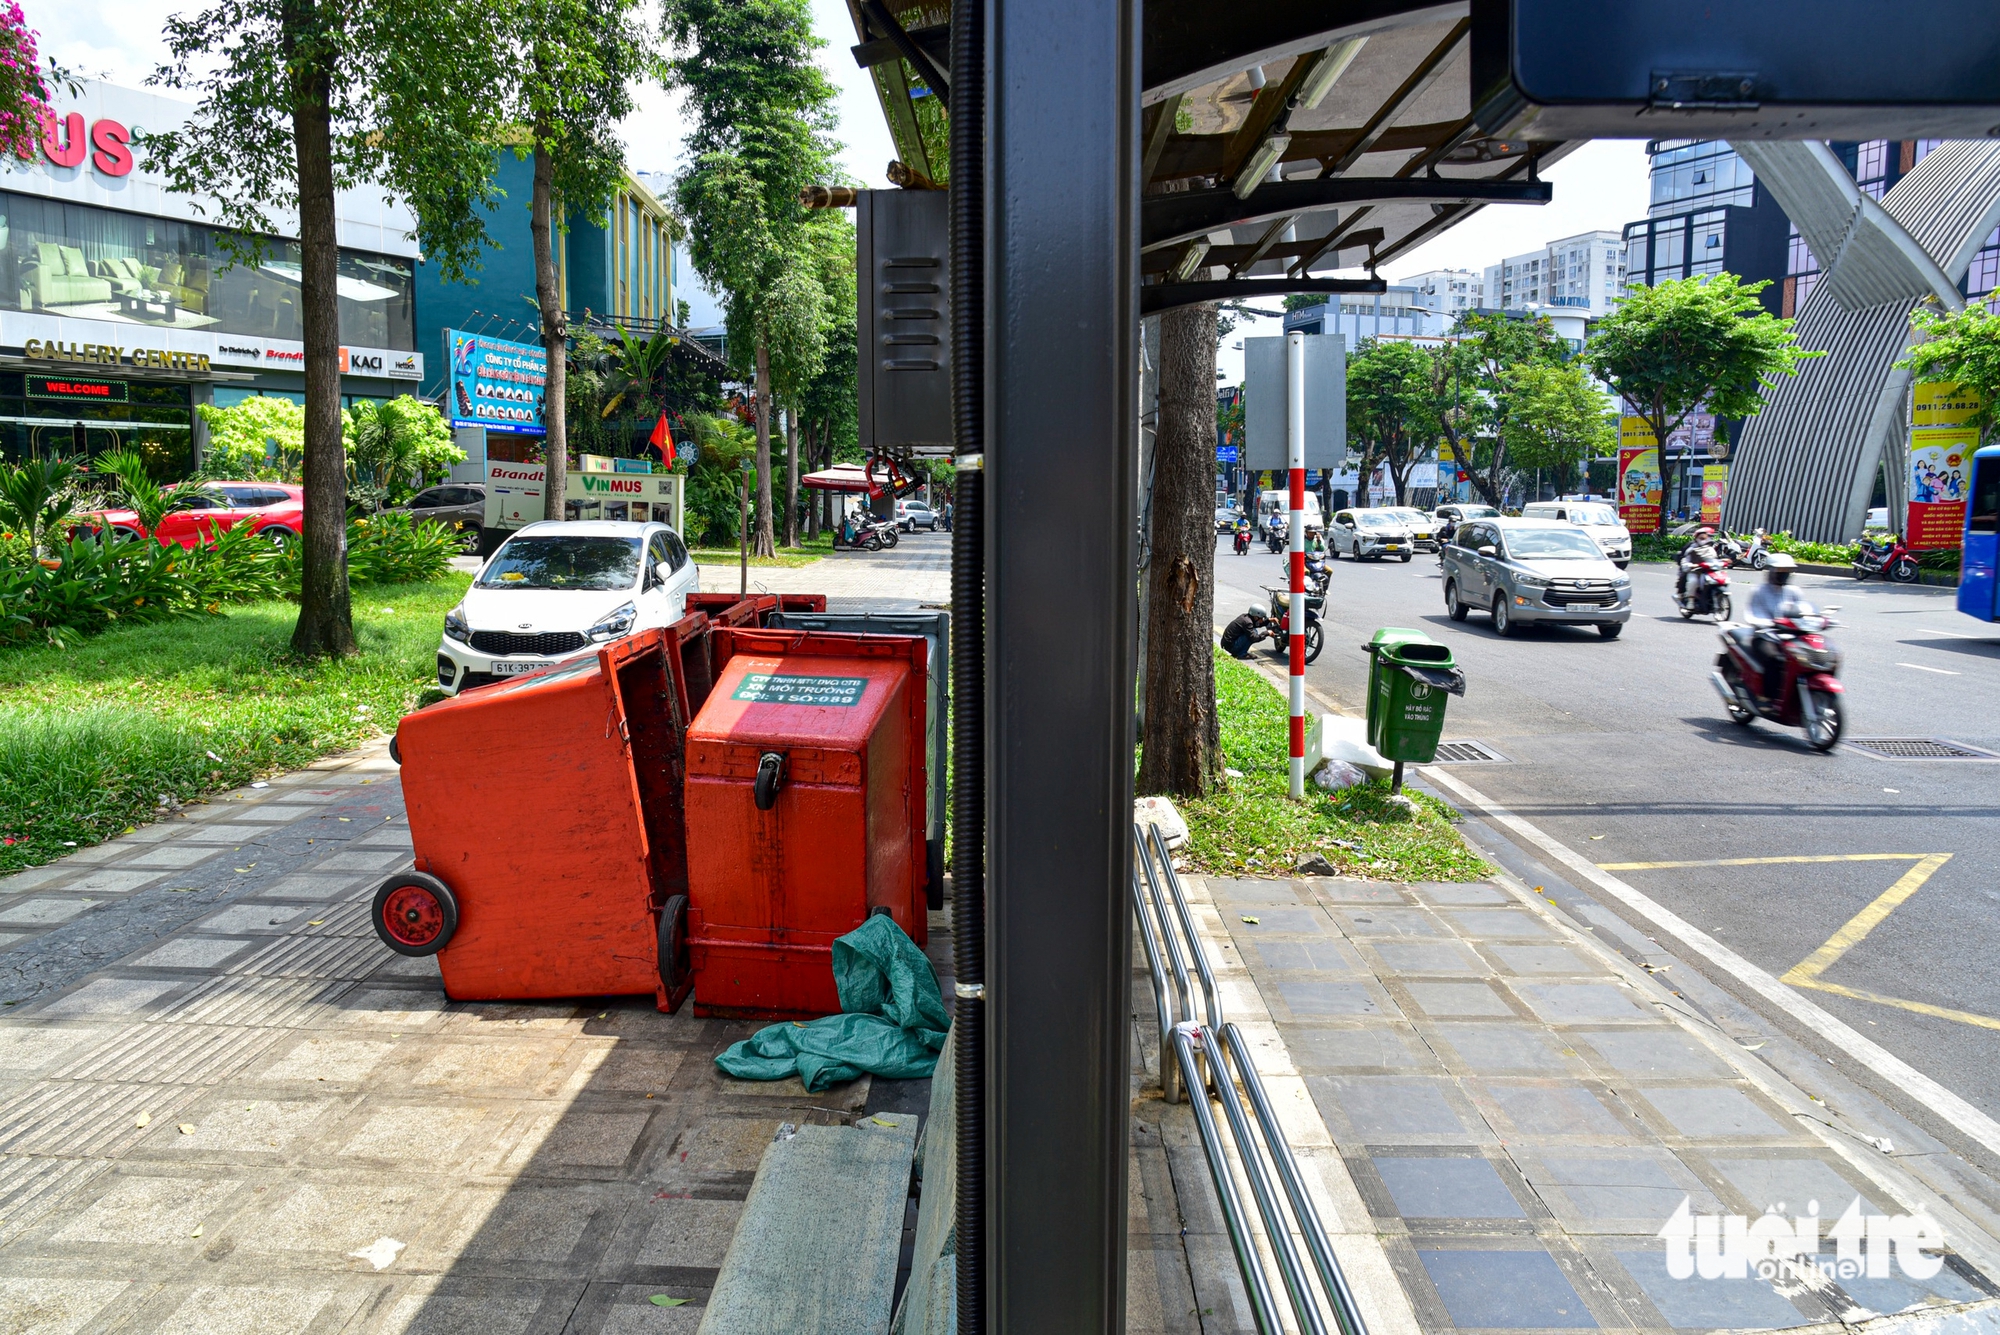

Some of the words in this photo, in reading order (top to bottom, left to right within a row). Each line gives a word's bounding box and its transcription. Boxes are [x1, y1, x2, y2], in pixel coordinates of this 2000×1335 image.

[17, 101, 133, 177] US
[25, 338, 124, 365] GALLERY
[132, 348, 212, 372] CENTER
[266, 350, 304, 360] Brandt
[352, 354, 382, 370] KACI
[485, 352, 502, 366] CÔNG
[504, 357, 512, 366] TY
[513, 356, 521, 368] CỔ
[522, 360, 538, 372] PHẦN
[46, 382, 110, 396] WELCOME
[1916, 402, 1978, 411] 0911.29.68.28
[491, 468, 545, 481] Brandt
[582, 476, 642, 493] VINMUS
[797, 686, 856, 695] TRƯỜNG
